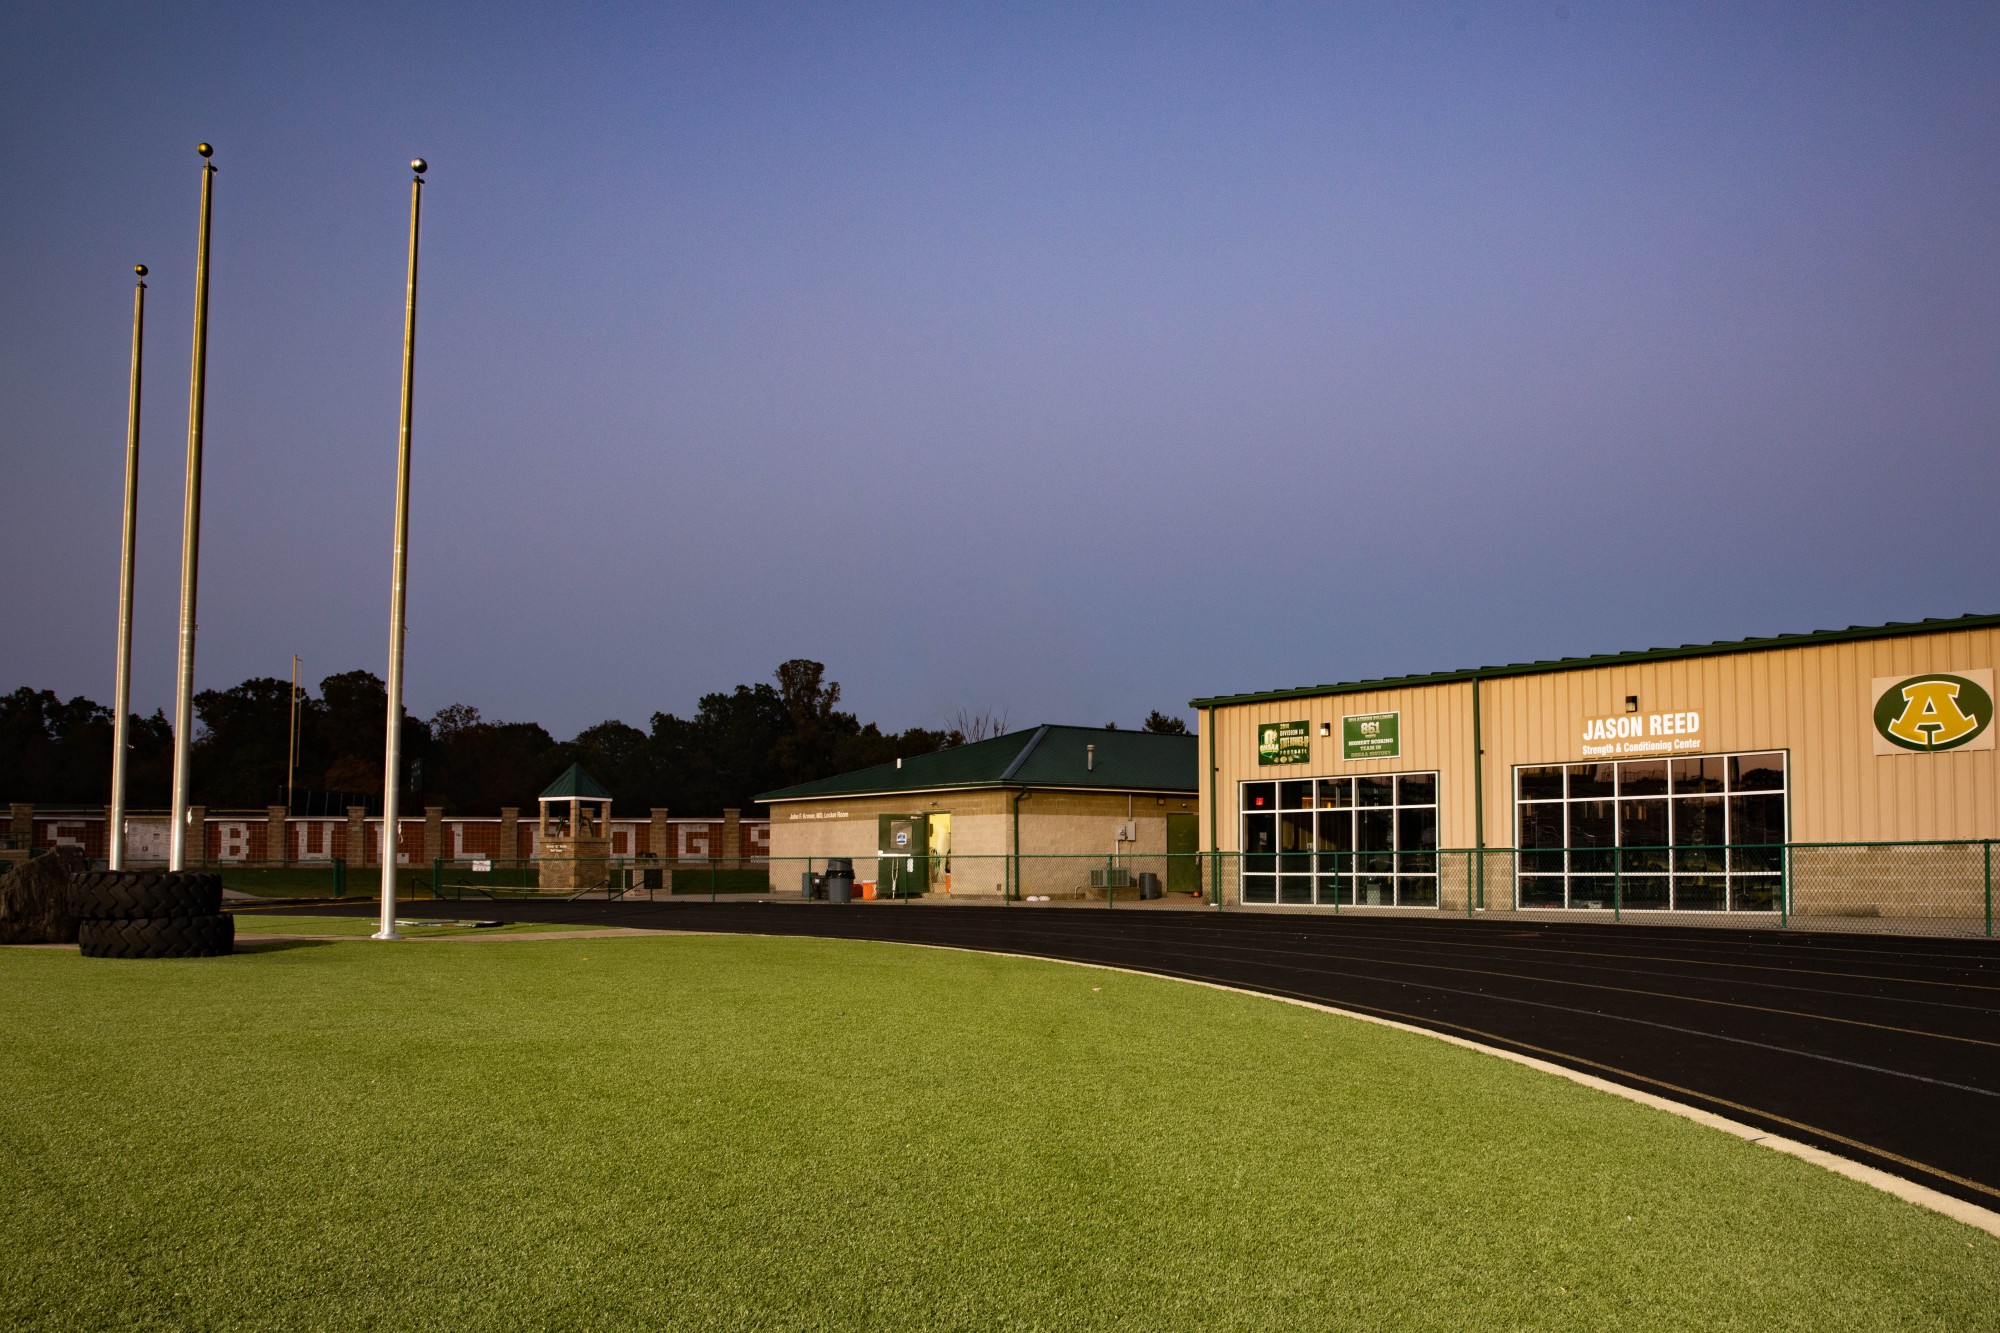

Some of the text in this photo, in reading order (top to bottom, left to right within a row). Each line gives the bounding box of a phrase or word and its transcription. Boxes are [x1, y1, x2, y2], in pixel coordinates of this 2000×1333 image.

[1888, 680, 1978, 745] A
[1361, 722, 1380, 734] 861
[1583, 712, 1699, 740] JASON REED
[1583, 738, 1700, 756] Strength & Conditioning Center
